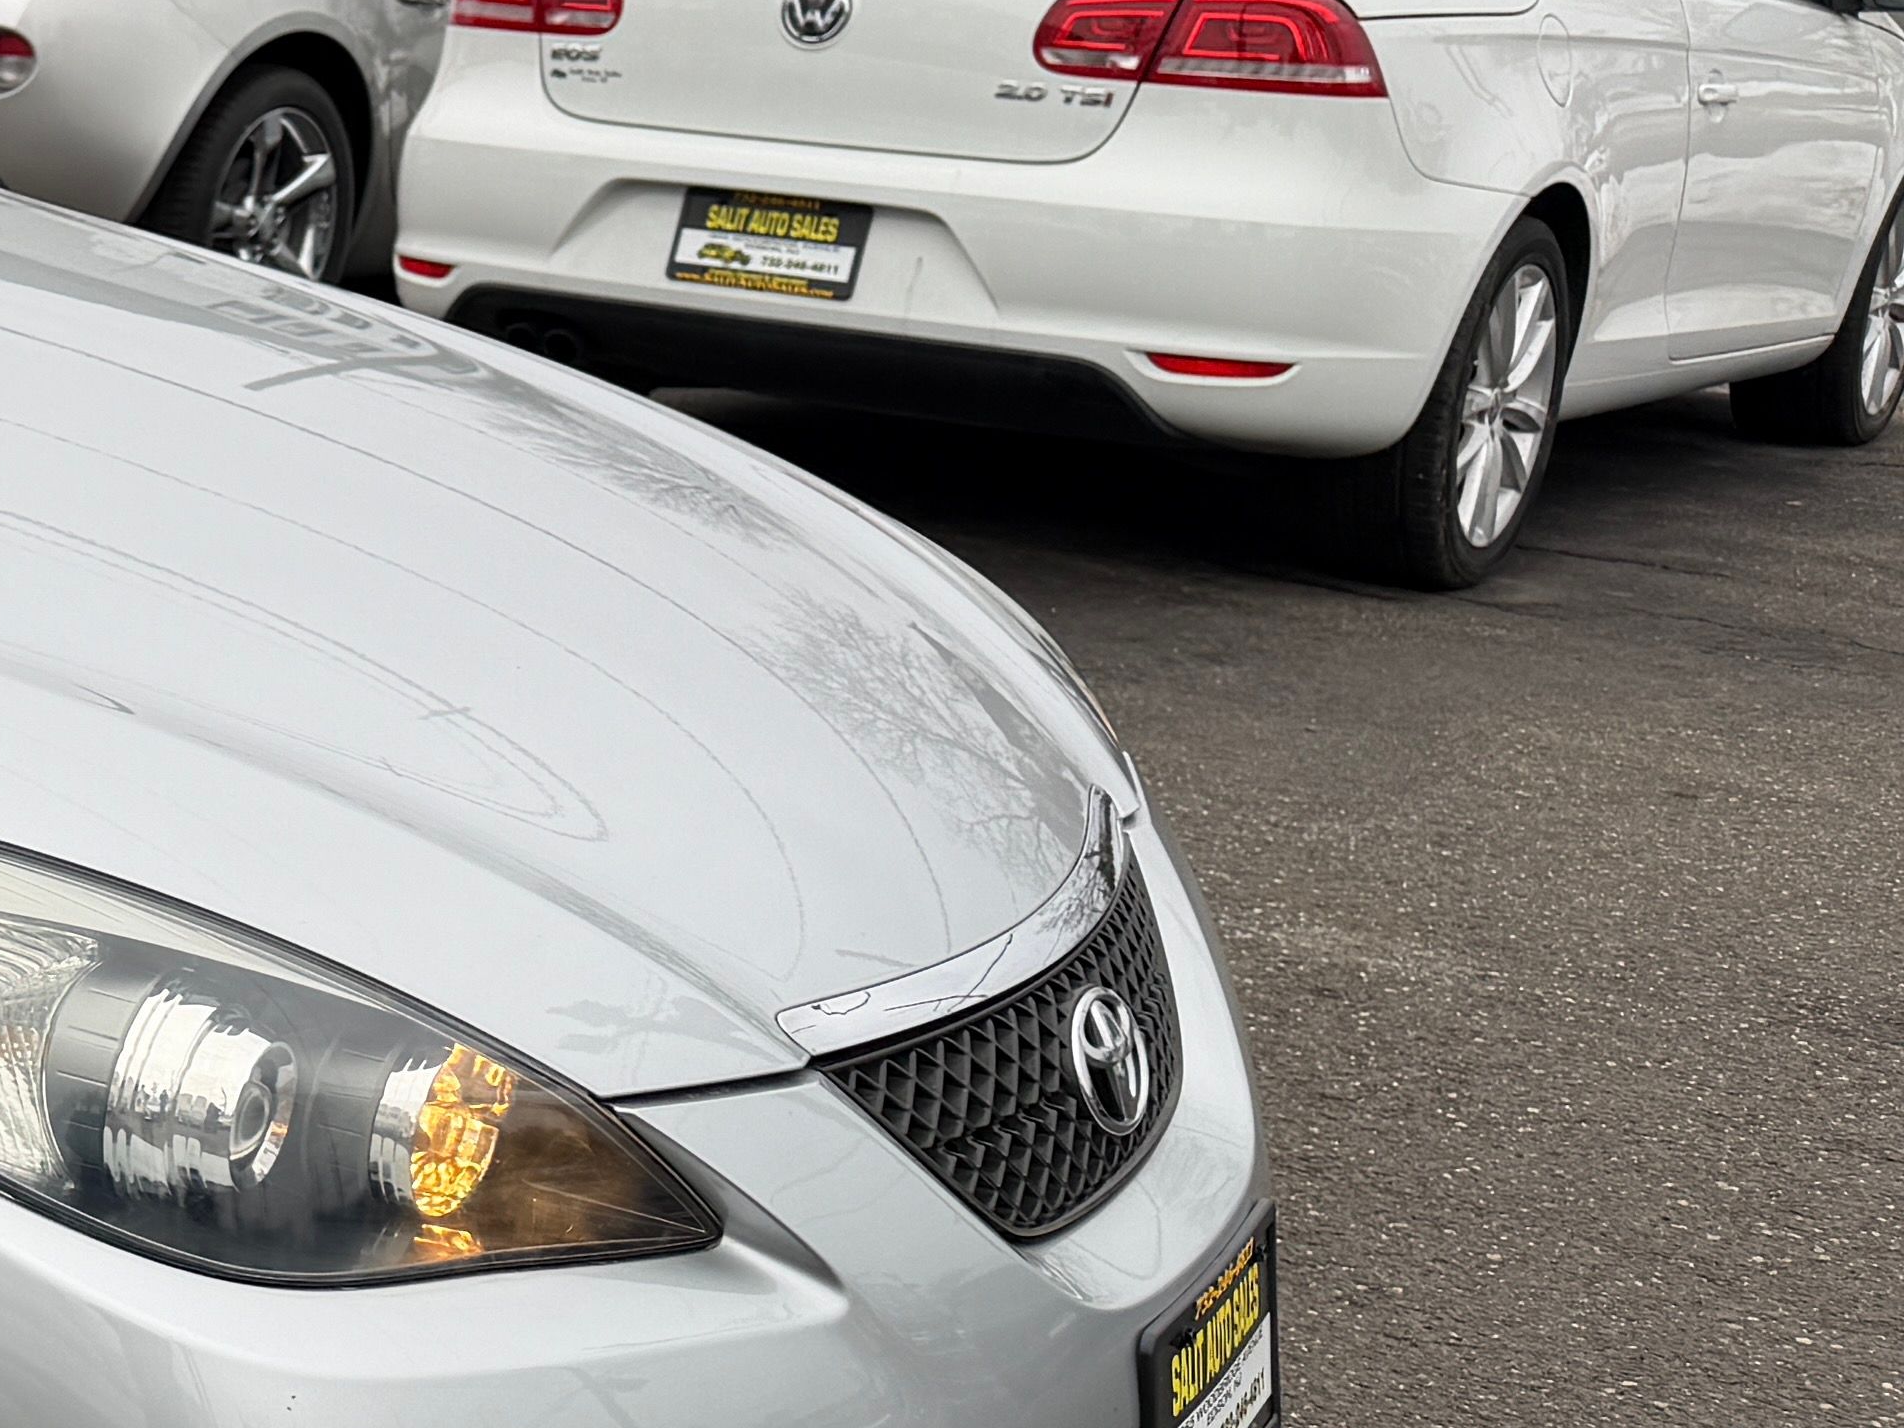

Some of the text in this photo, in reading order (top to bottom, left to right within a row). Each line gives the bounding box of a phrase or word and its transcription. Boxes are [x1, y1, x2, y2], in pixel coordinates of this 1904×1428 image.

[1058, 84, 1115, 108] TSI
[705, 204, 750, 232] SALIT
[748, 209, 790, 238] AUTO
[790, 215, 841, 243] SALES
[1171, 1262, 1261, 1418] SALIT AUTO SALES
